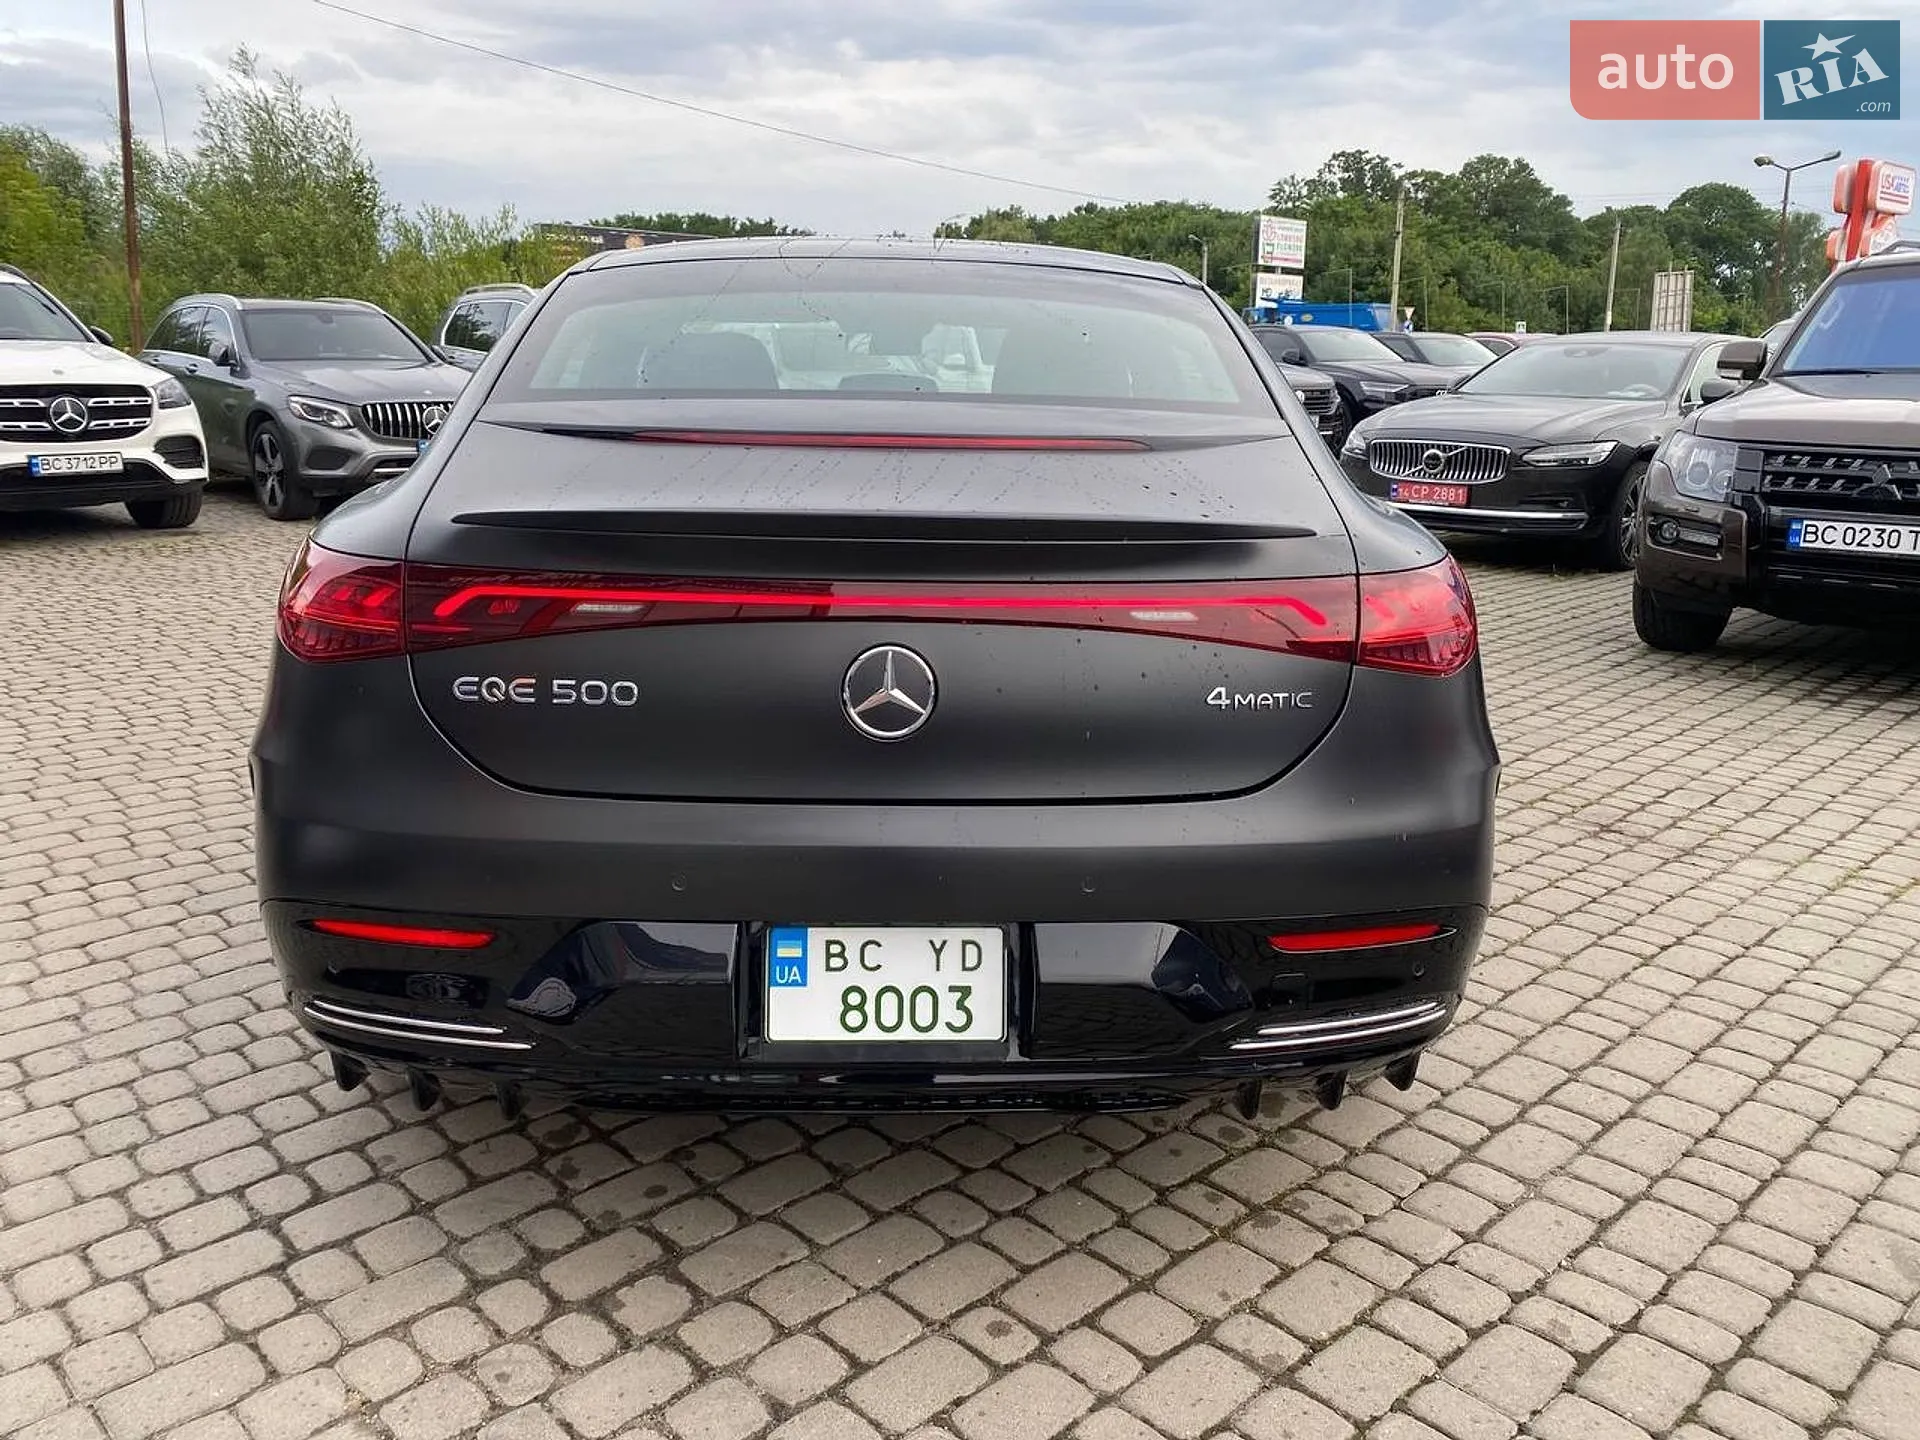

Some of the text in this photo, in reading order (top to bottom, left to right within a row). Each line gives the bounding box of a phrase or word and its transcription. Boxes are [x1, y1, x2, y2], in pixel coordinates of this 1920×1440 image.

[40, 457, 62, 471] BC
[64, 456, 96, 470] 3712
[98, 455, 118, 468] PP
[1412, 485, 1429, 499] CP
[1433, 486, 1465, 502] 2881
[1803, 523, 1838, 545] BC
[1842, 526, 1902, 549] 0230
[452, 676, 639, 706] EQE 500
[1206, 686, 1313, 711] 4MATIC
[824, 939, 983, 972] BC YD
[775, 965, 802, 984] UA
[839, 984, 974, 1033] 8003
